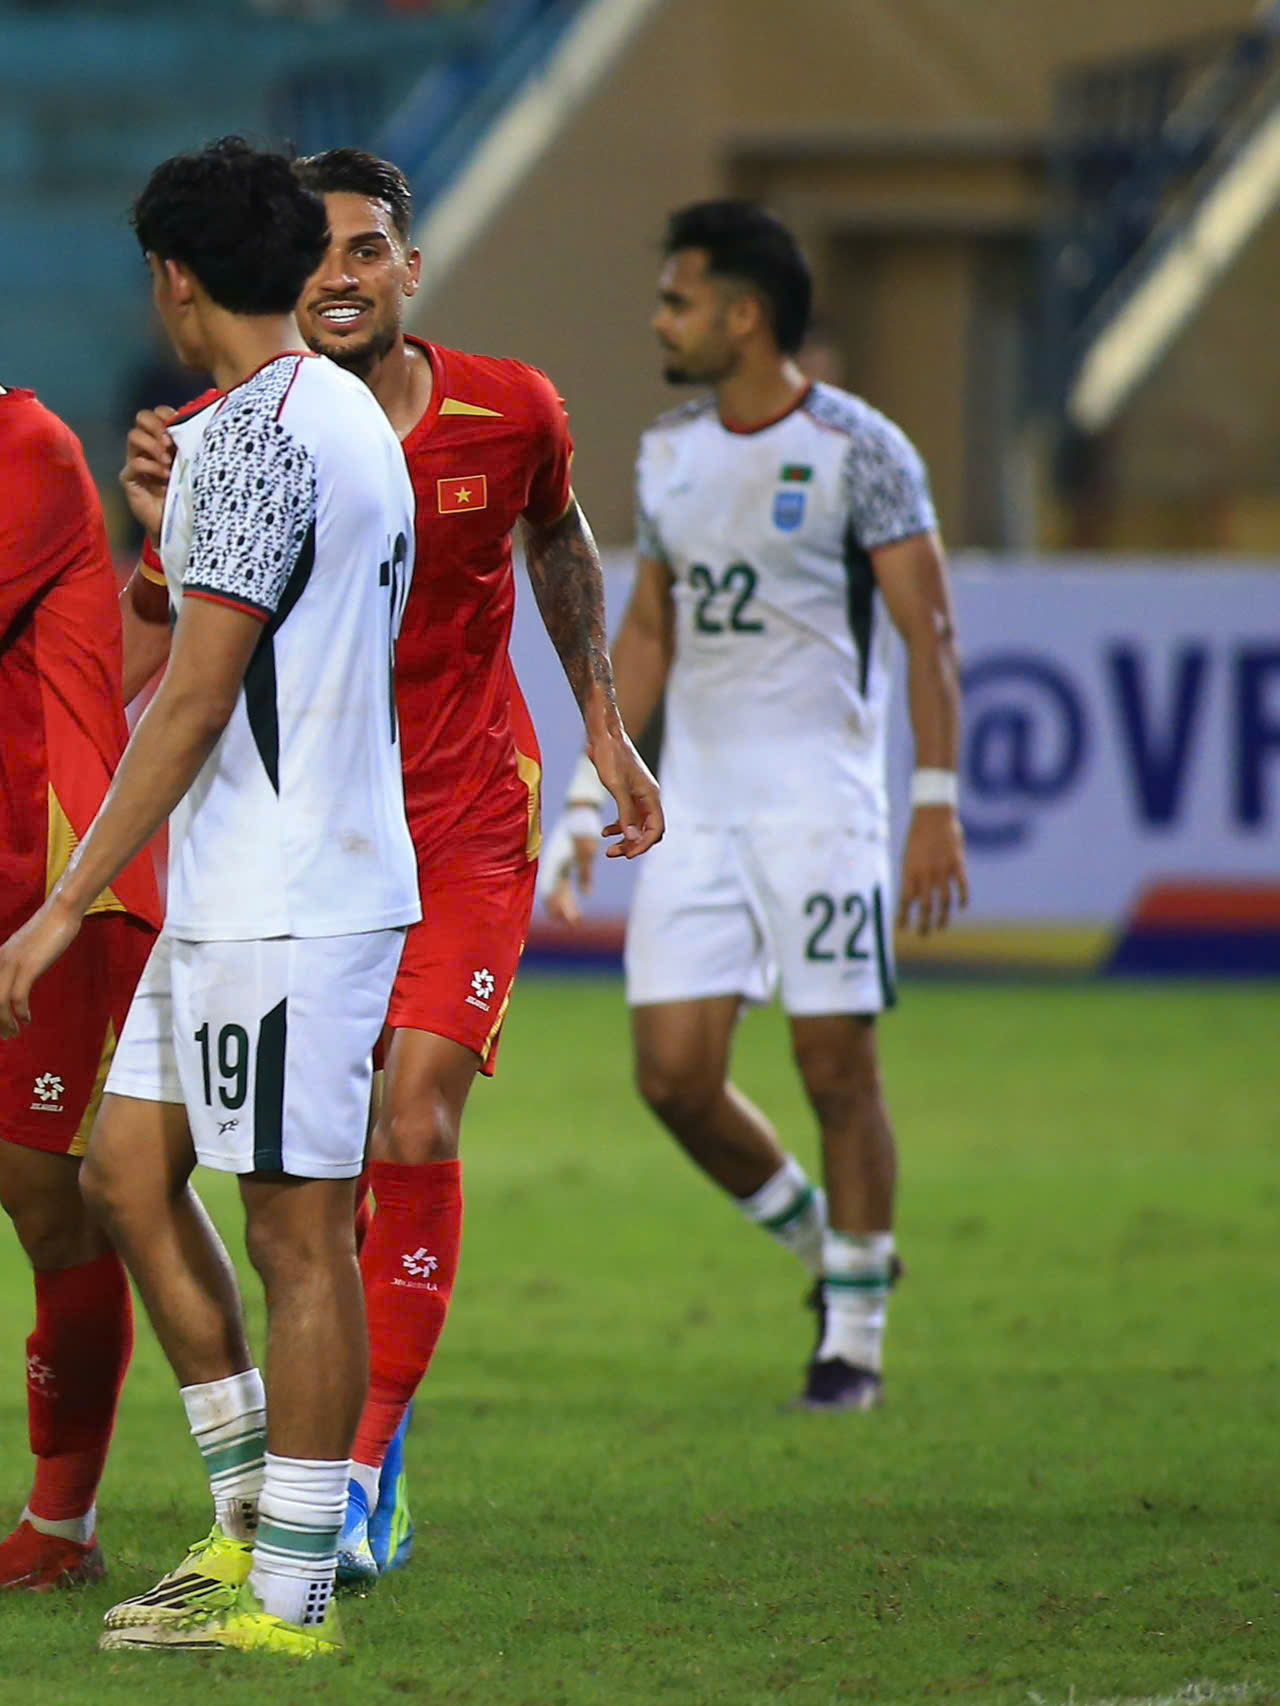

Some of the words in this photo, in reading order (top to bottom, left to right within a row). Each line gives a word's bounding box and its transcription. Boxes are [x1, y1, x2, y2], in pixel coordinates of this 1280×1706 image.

[689, 563, 764, 634] 22
[804, 892, 869, 961] 22
[194, 1022, 249, 1110] 19
